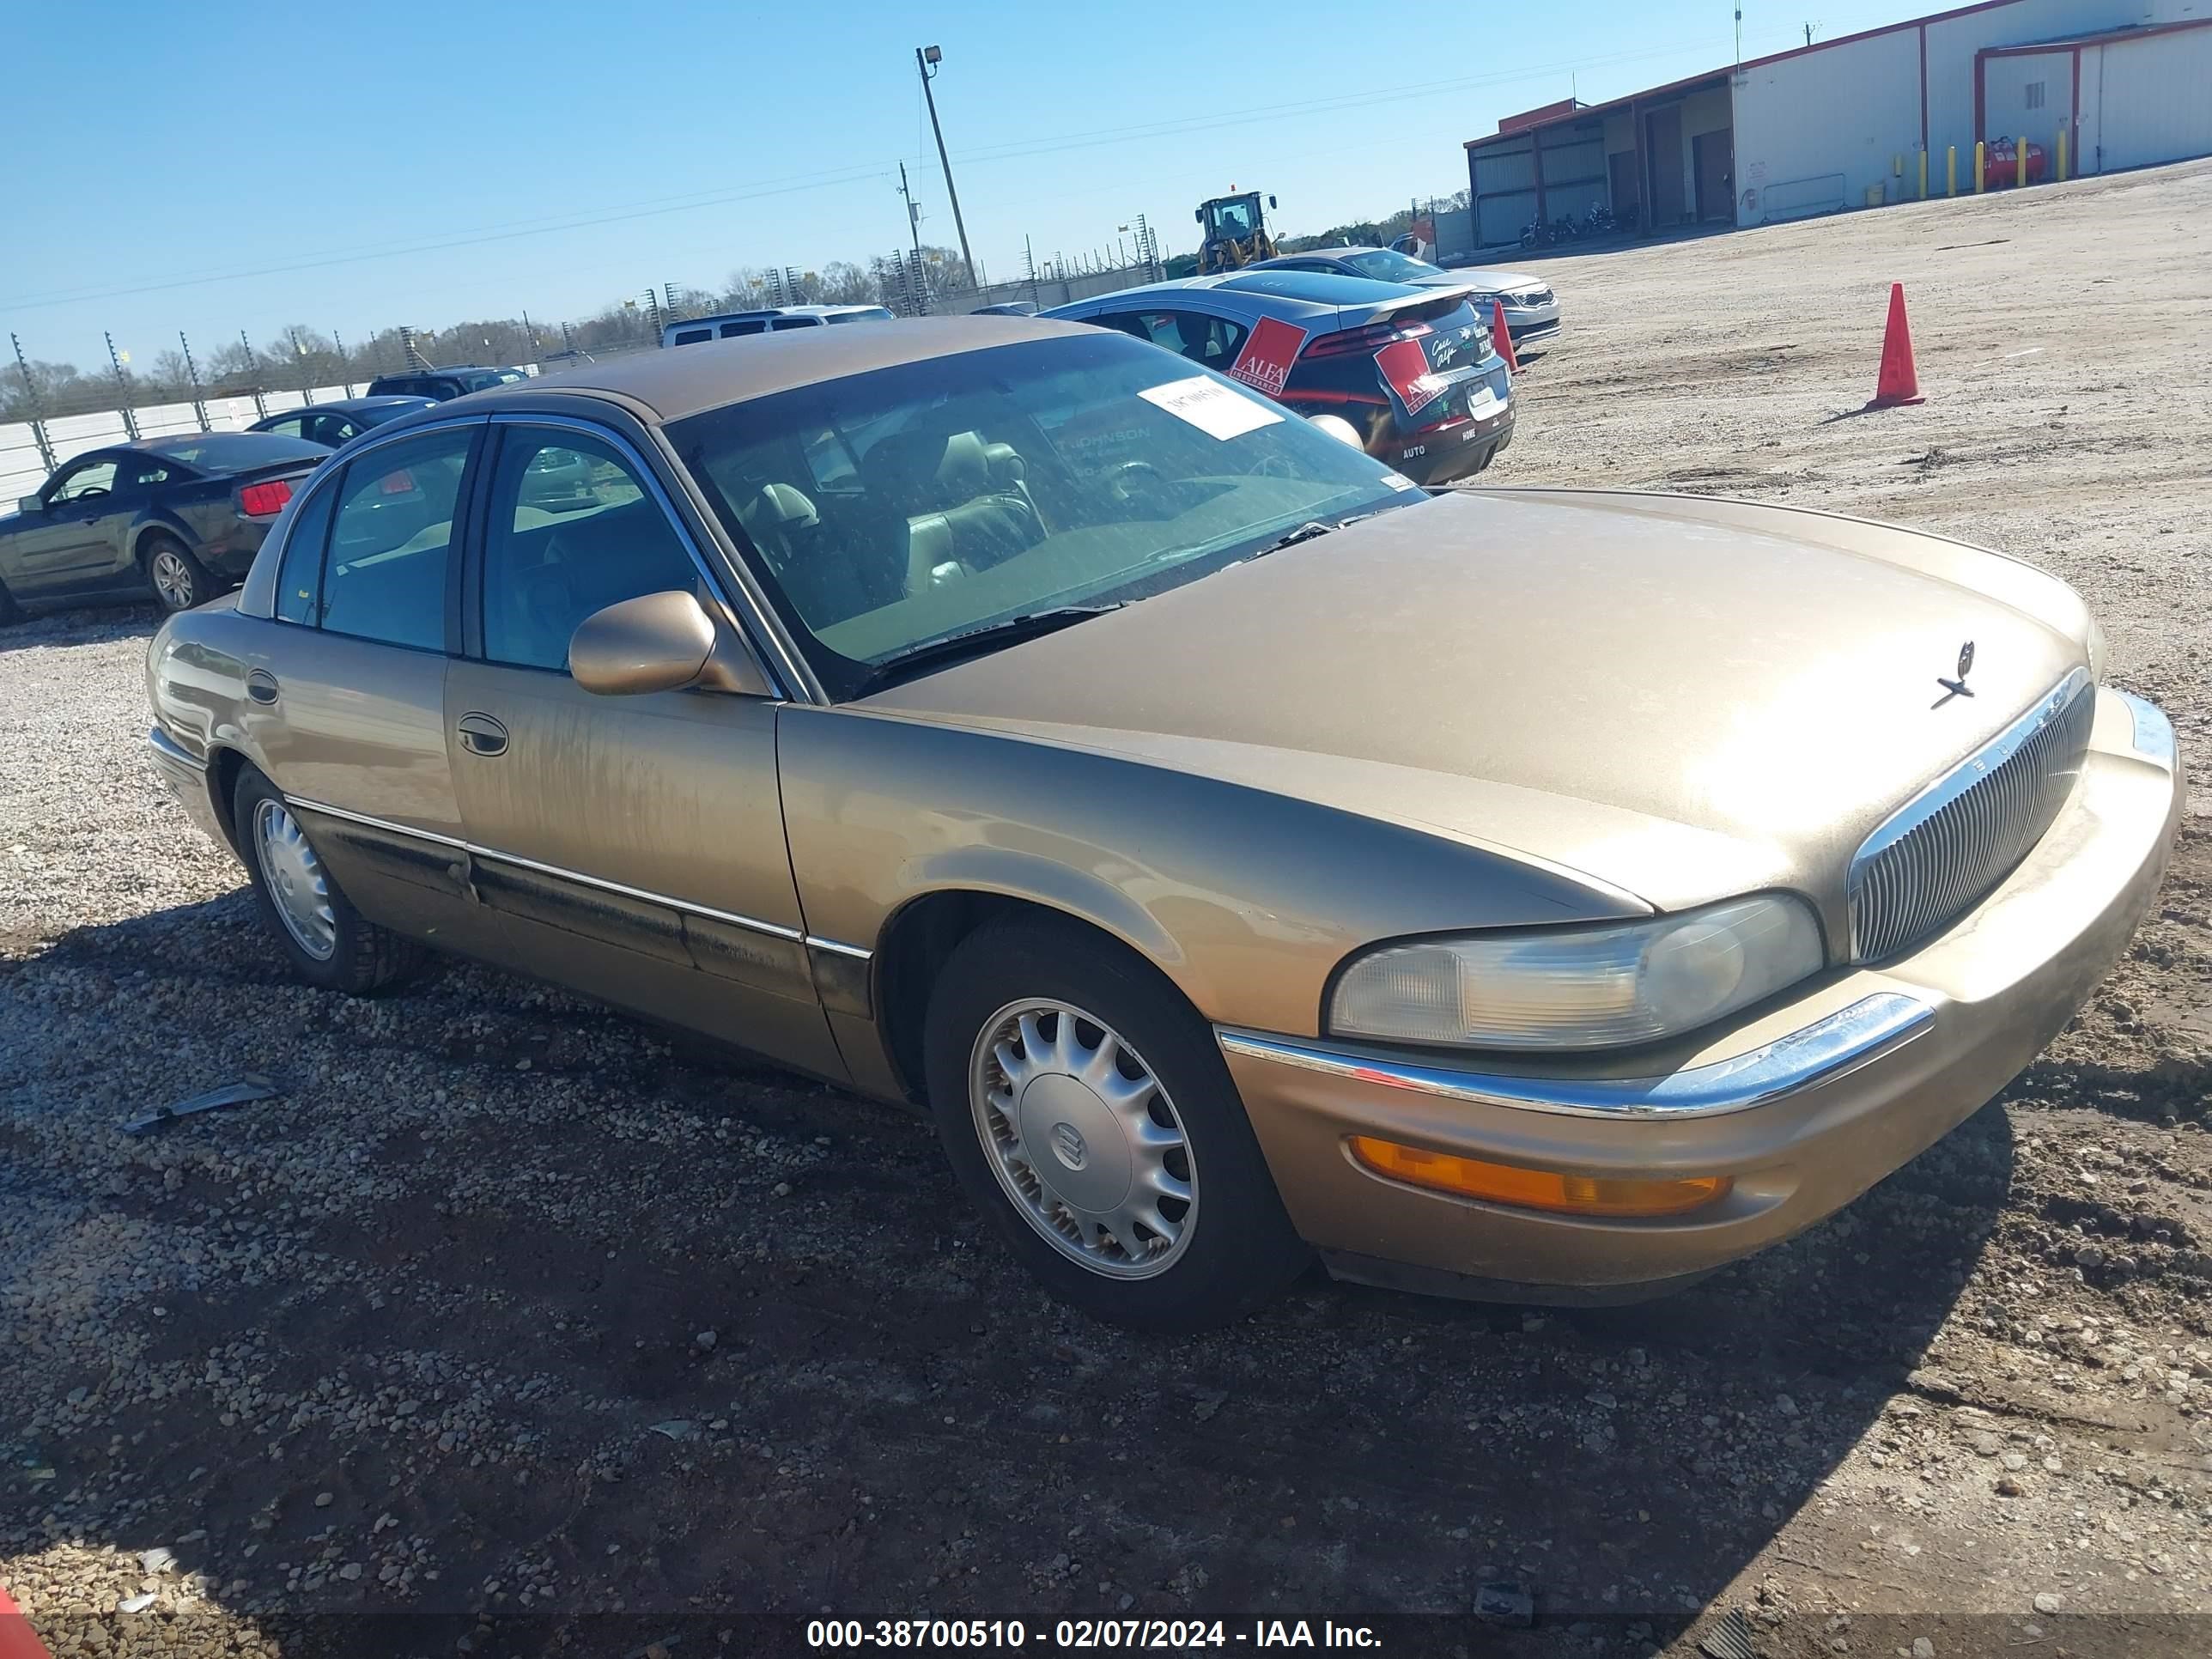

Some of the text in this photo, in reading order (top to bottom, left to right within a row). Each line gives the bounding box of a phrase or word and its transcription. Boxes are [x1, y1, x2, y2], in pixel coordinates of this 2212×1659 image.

[1233, 370, 1280, 393] INSURANCE
[1242, 356, 1285, 385] ALFA
[1410, 386, 1447, 412] INSURA
[1462, 428, 1476, 441] HOME
[1403, 445, 1425, 460] AUTO
